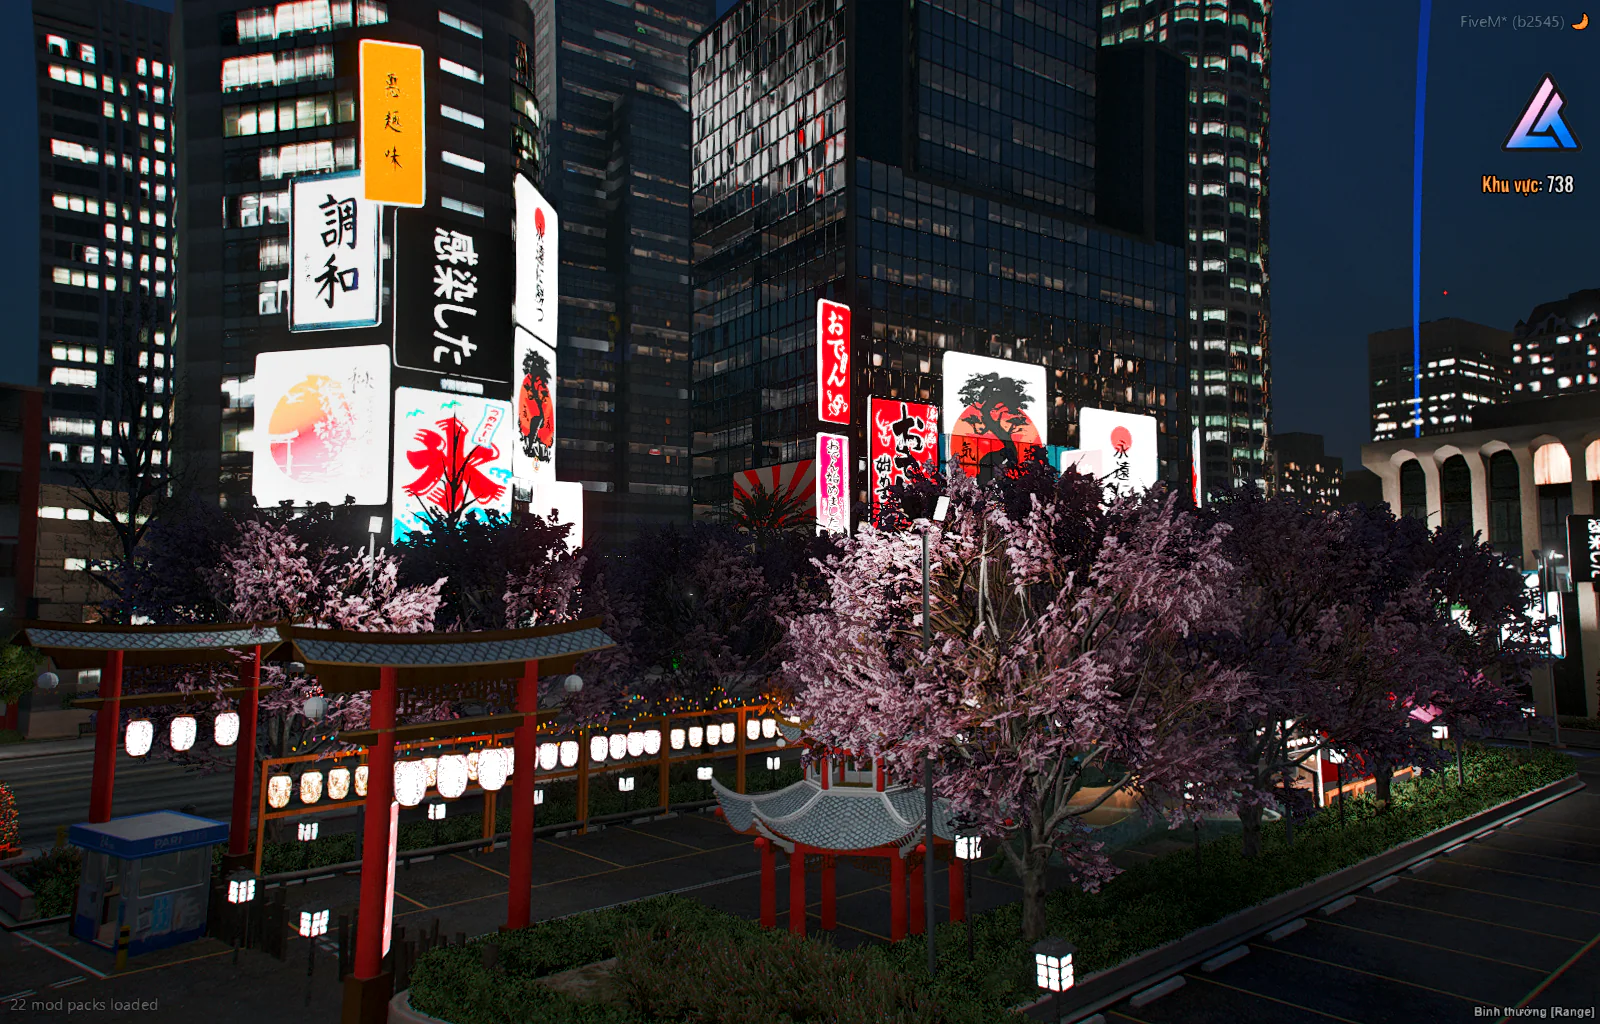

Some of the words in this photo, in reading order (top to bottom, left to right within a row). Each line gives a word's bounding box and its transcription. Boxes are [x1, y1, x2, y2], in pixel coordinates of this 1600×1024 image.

[314, 193, 359, 309] 調和
[433, 227, 480, 366] 感染した
[827, 310, 847, 388] おでん
